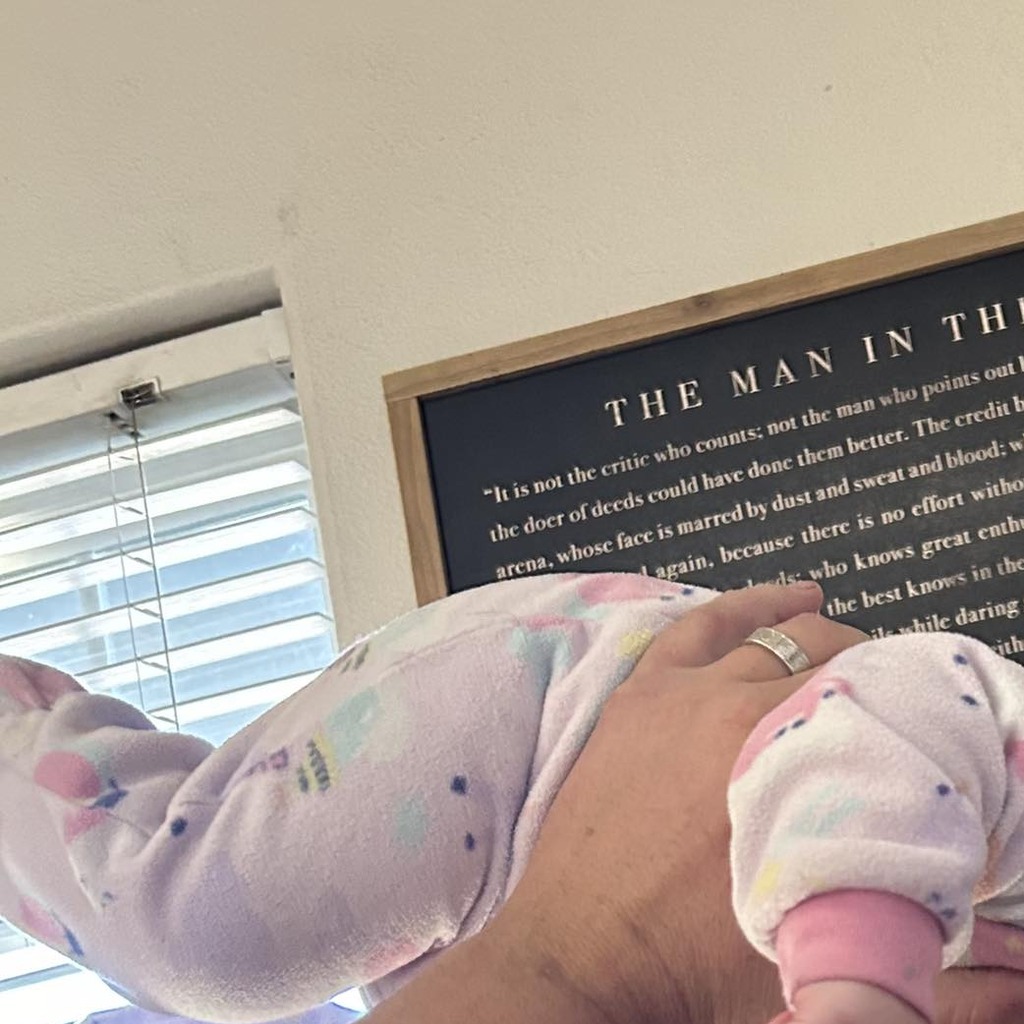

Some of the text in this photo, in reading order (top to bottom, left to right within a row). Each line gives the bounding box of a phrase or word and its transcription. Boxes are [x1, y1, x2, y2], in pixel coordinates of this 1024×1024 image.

[604, 379, 703, 427] THE
[730, 346, 832, 397] MAN
[862, 325, 913, 364] IN
[489, 519, 520, 542] the
[521, 507, 566, 534] doer
[567, 502, 591, 523] of
[589, 488, 644, 518] deeds
[647, 475, 699, 504] could
[700, 469, 744, 491] have
[747, 457, 793, 479] done
[796, 445, 844, 467] them
[911, 416, 951, 437] The
[953, 400, 1011, 427] credit
[512, 482, 530, 499] is
[532, 475, 563, 494] not
[566, 466, 597, 485] the
[600, 452, 650, 476] critic
[653, 443, 692, 463] who
[766, 416, 798, 436] not
[800, 408, 831, 427] the
[835, 398, 875, 419] man
[878, 386, 918, 406] who
[921, 372, 980, 402] points
[983, 362, 1016, 381] out
[555, 540, 613, 564] whose
[616, 530, 653, 550] face
[656, 523, 674, 540] is
[676, 503, 744, 536] marred
[744, 500, 767, 521] by
[771, 491, 812, 512] dust
[814, 476, 850, 502] and
[852, 467, 906, 492] sweat
[907, 454, 943, 479] and
[718, 535, 794, 563] because
[800, 521, 850, 544] there
[856, 513, 875, 530] is
[880, 508, 905, 525] no
[910, 492, 964, 517] effort
[808, 559, 848, 580] who
[853, 545, 915, 571] knows
[921, 530, 972, 560] great
[826, 597, 857, 617] the
[860, 587, 903, 608] best
[905, 572, 966, 598] knows
[971, 564, 992, 581] in
[954, 599, 1020, 626] daring
